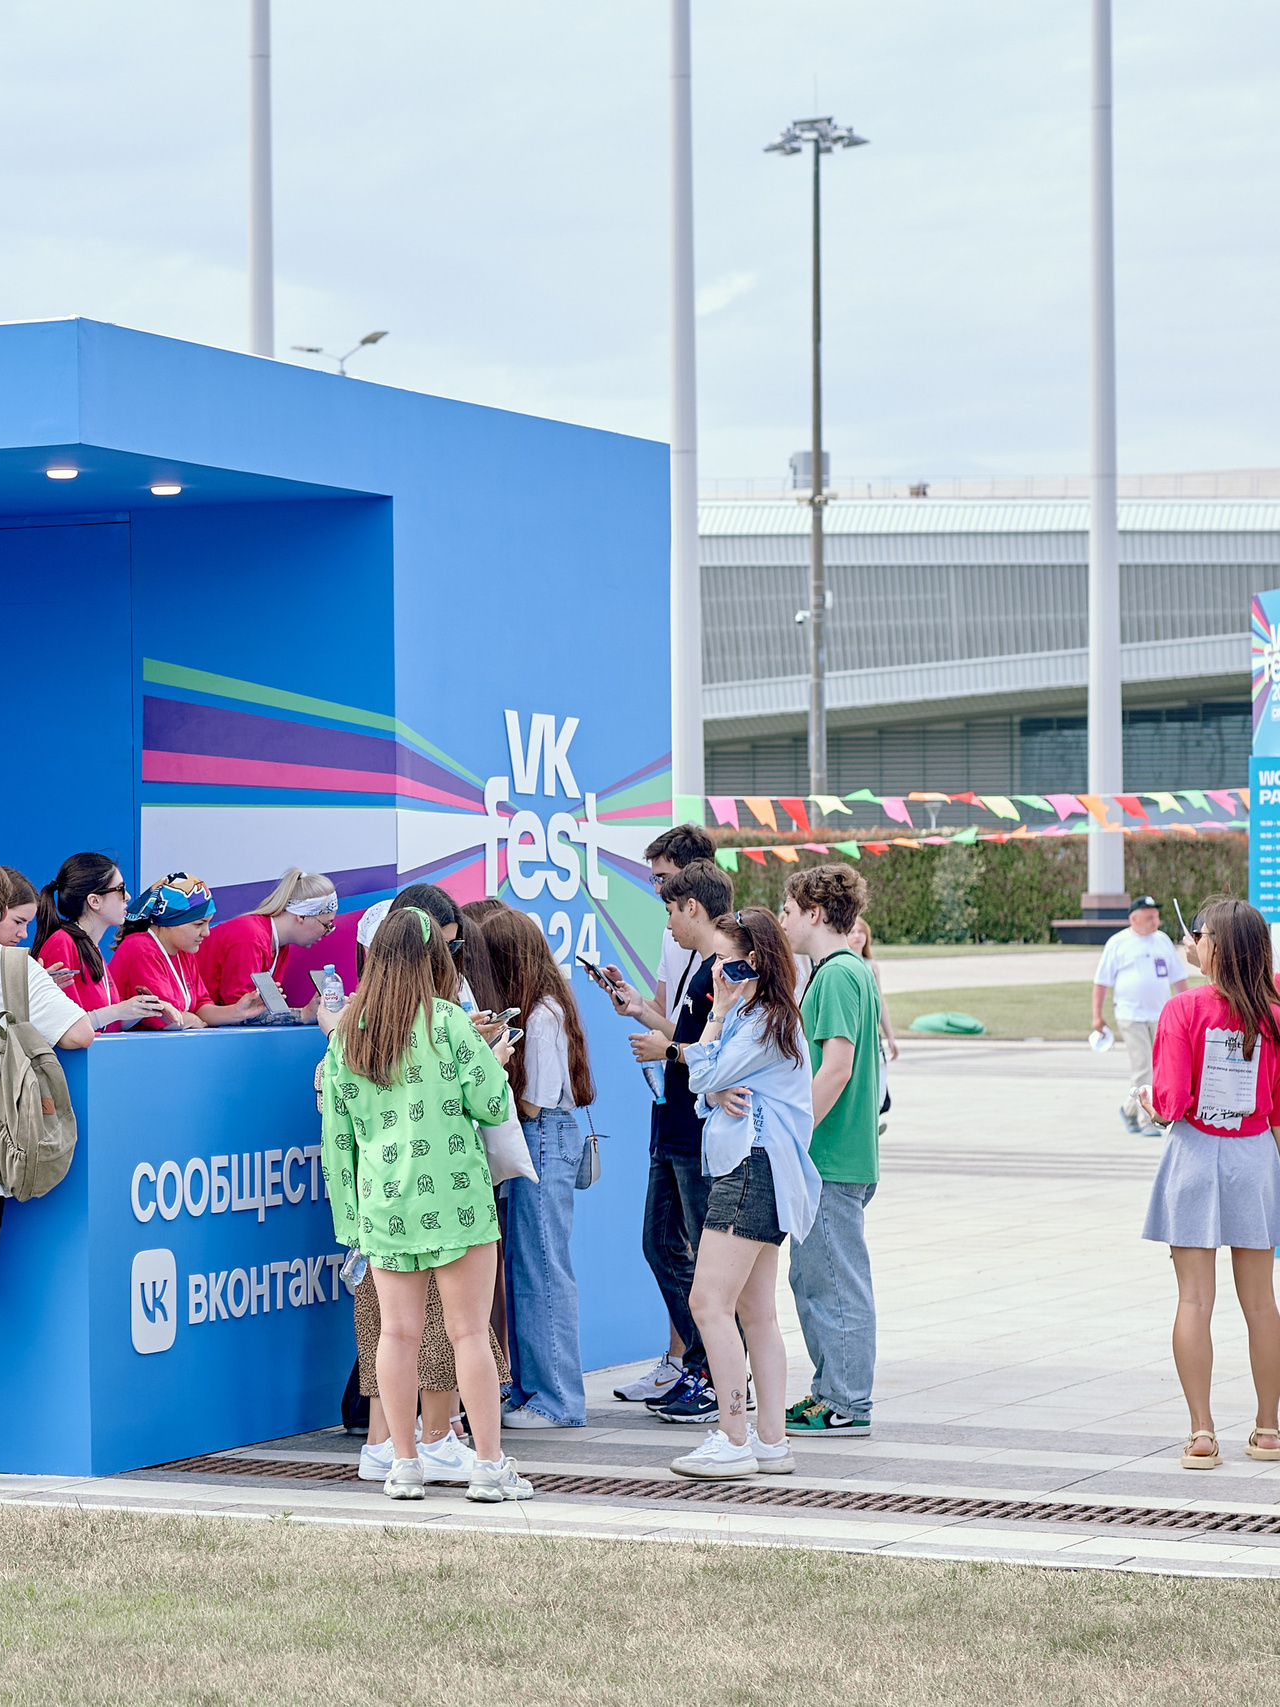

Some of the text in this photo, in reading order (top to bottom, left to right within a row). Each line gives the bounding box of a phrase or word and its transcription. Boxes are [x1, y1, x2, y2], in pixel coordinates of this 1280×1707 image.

[504, 709, 581, 799] VK
[484, 776, 609, 901] fest
[131, 1144, 331, 1223] СООБЩЕСТ
